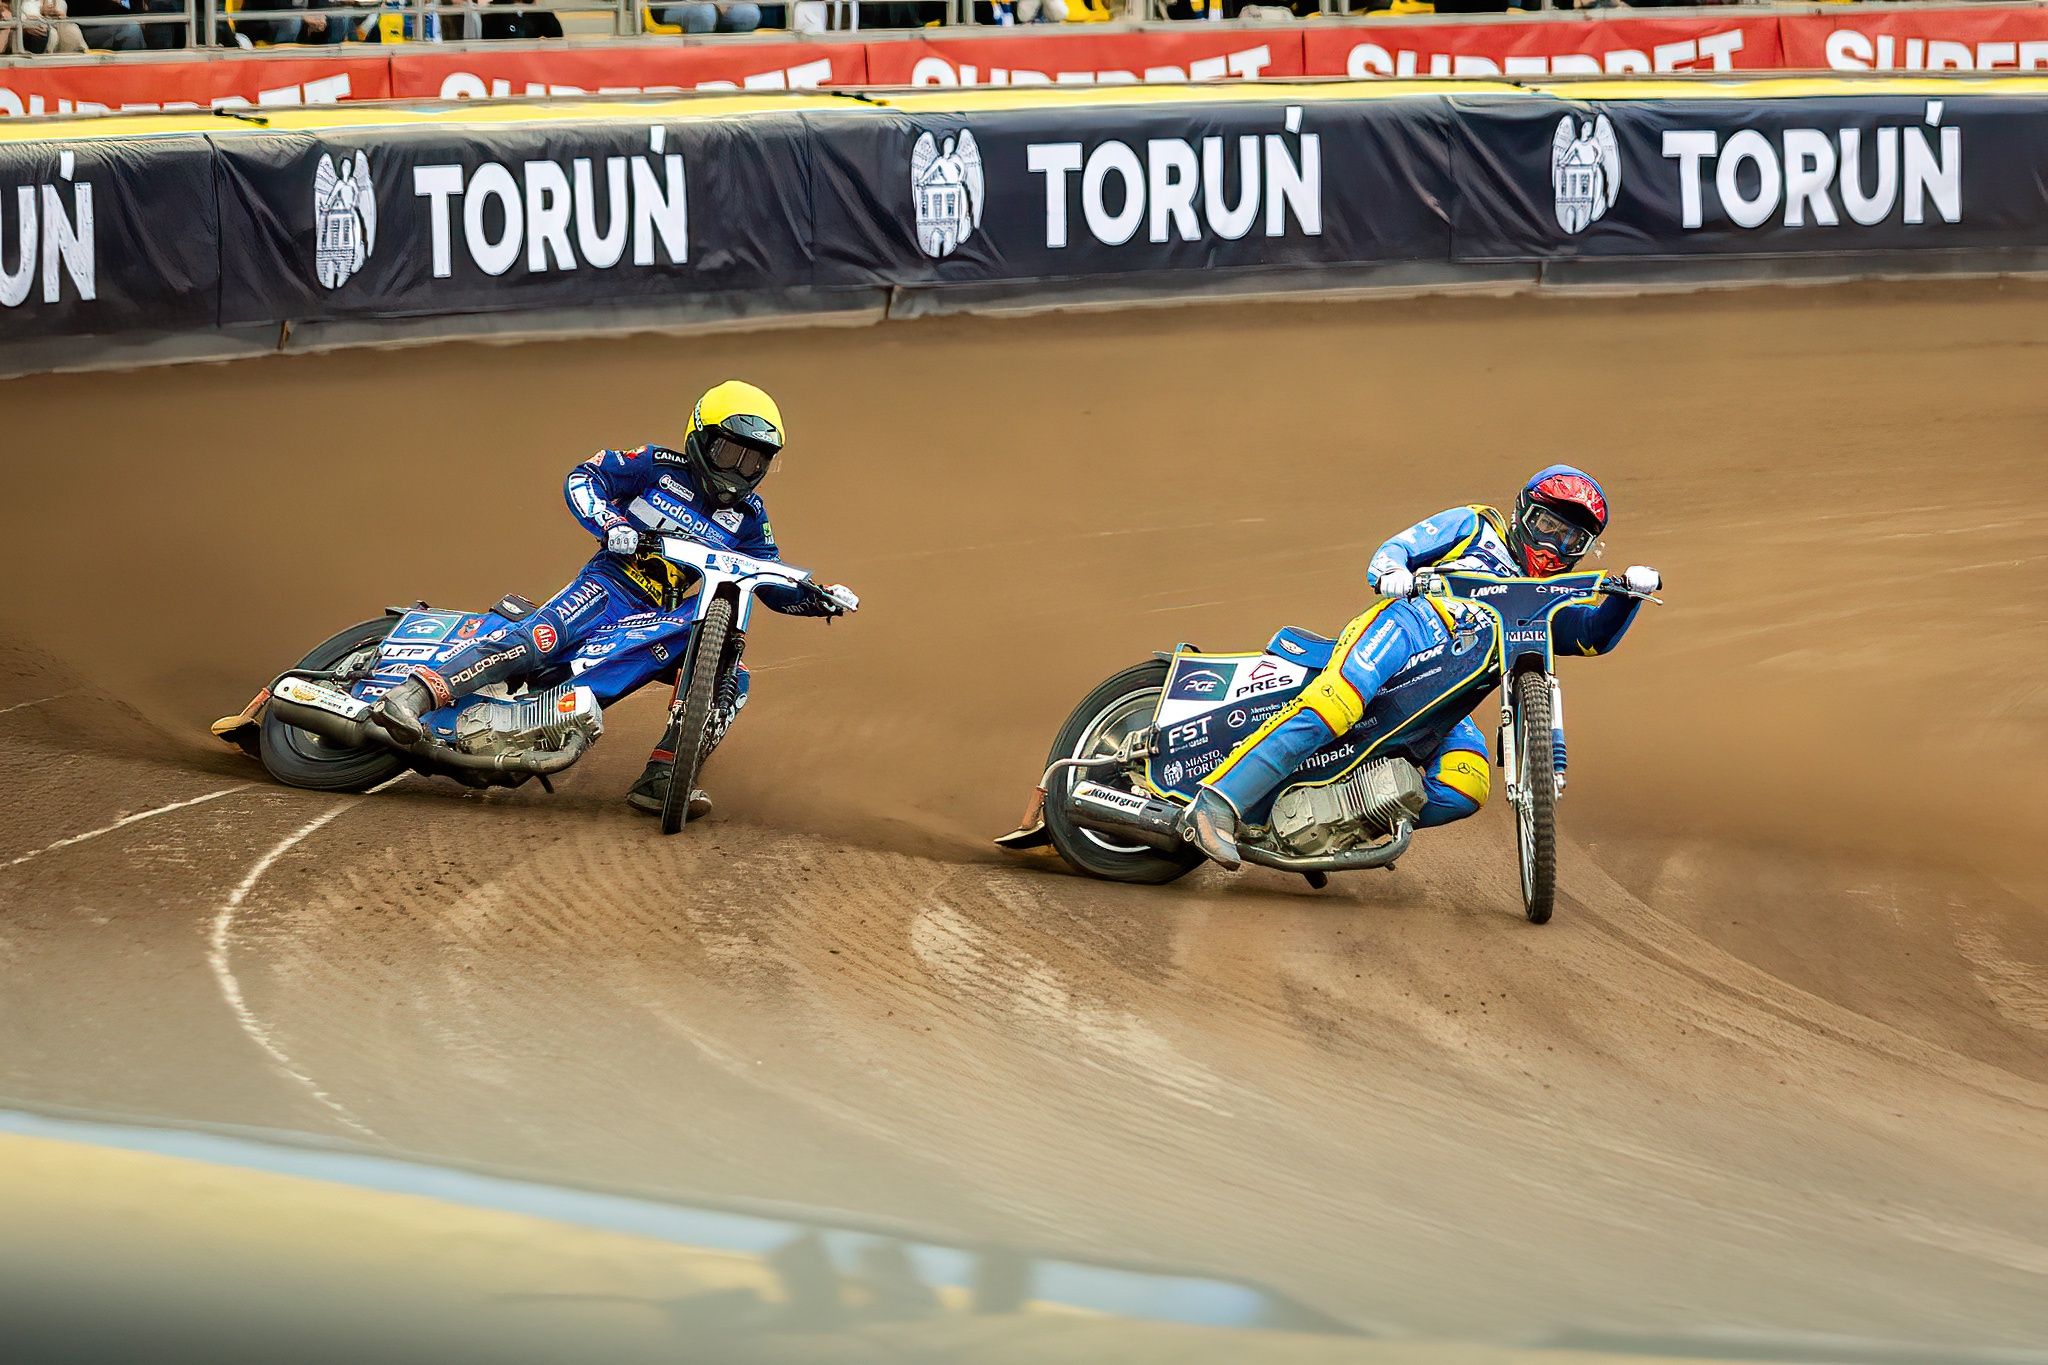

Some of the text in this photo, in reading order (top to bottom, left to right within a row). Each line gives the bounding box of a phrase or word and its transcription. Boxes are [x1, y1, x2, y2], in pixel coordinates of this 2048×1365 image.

[1027, 106, 1322, 249] TORUŃ
[1662, 100, 1962, 229] TORUŃ
[413, 126, 688, 278] TORUŃ
[652, 493, 709, 536] budio.pl
[556, 580, 603, 621] ALMAK
[1470, 585, 1508, 598] LAVOR
[450, 645, 527, 686] POLCOPPER
[1394, 644, 1445, 677] AVOR
[1184, 680, 1218, 692] PGE
[1236, 675, 1293, 698] PRES
[1168, 716, 1212, 747] FST
[1185, 750, 1220, 768] MIASTO
